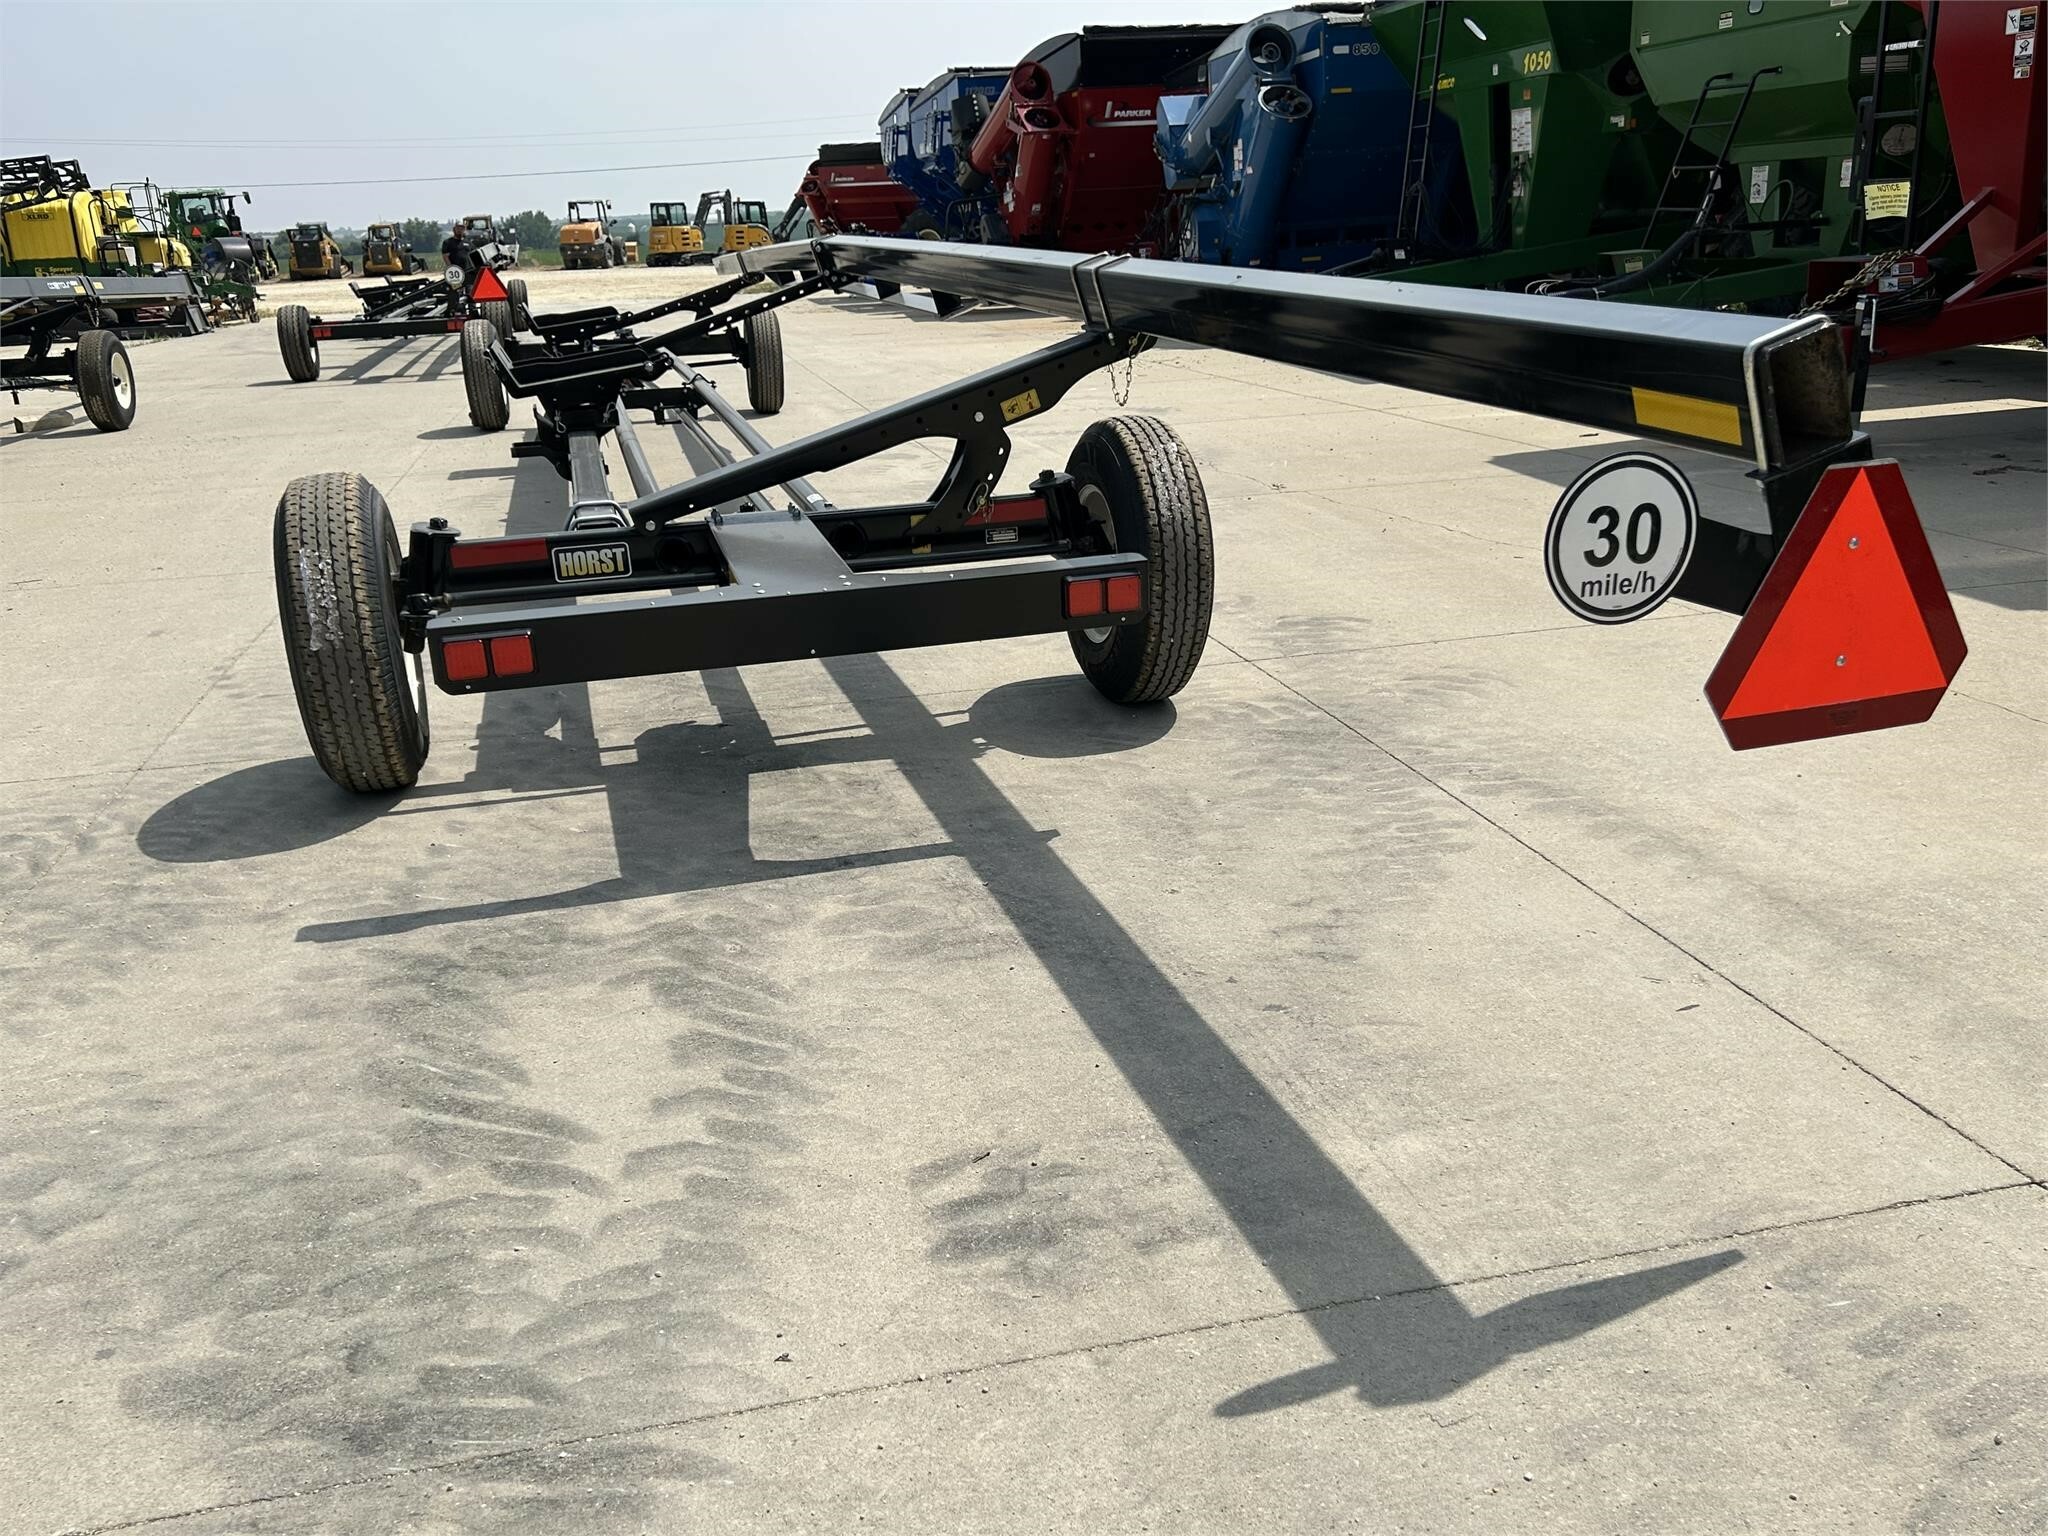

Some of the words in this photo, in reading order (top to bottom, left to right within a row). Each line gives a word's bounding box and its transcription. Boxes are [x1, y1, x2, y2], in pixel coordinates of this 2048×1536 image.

[1352, 42, 1379, 55] 850
[1524, 50, 1551, 74] 1050
[1114, 109, 1152, 118] PARKER
[1877, 184, 1901, 192] NOTICE
[449, 270, 460, 279] 30
[1583, 502, 1662, 567] 30
[559, 548, 625, 577] HORST
[1580, 570, 1656, 598] mile/h
